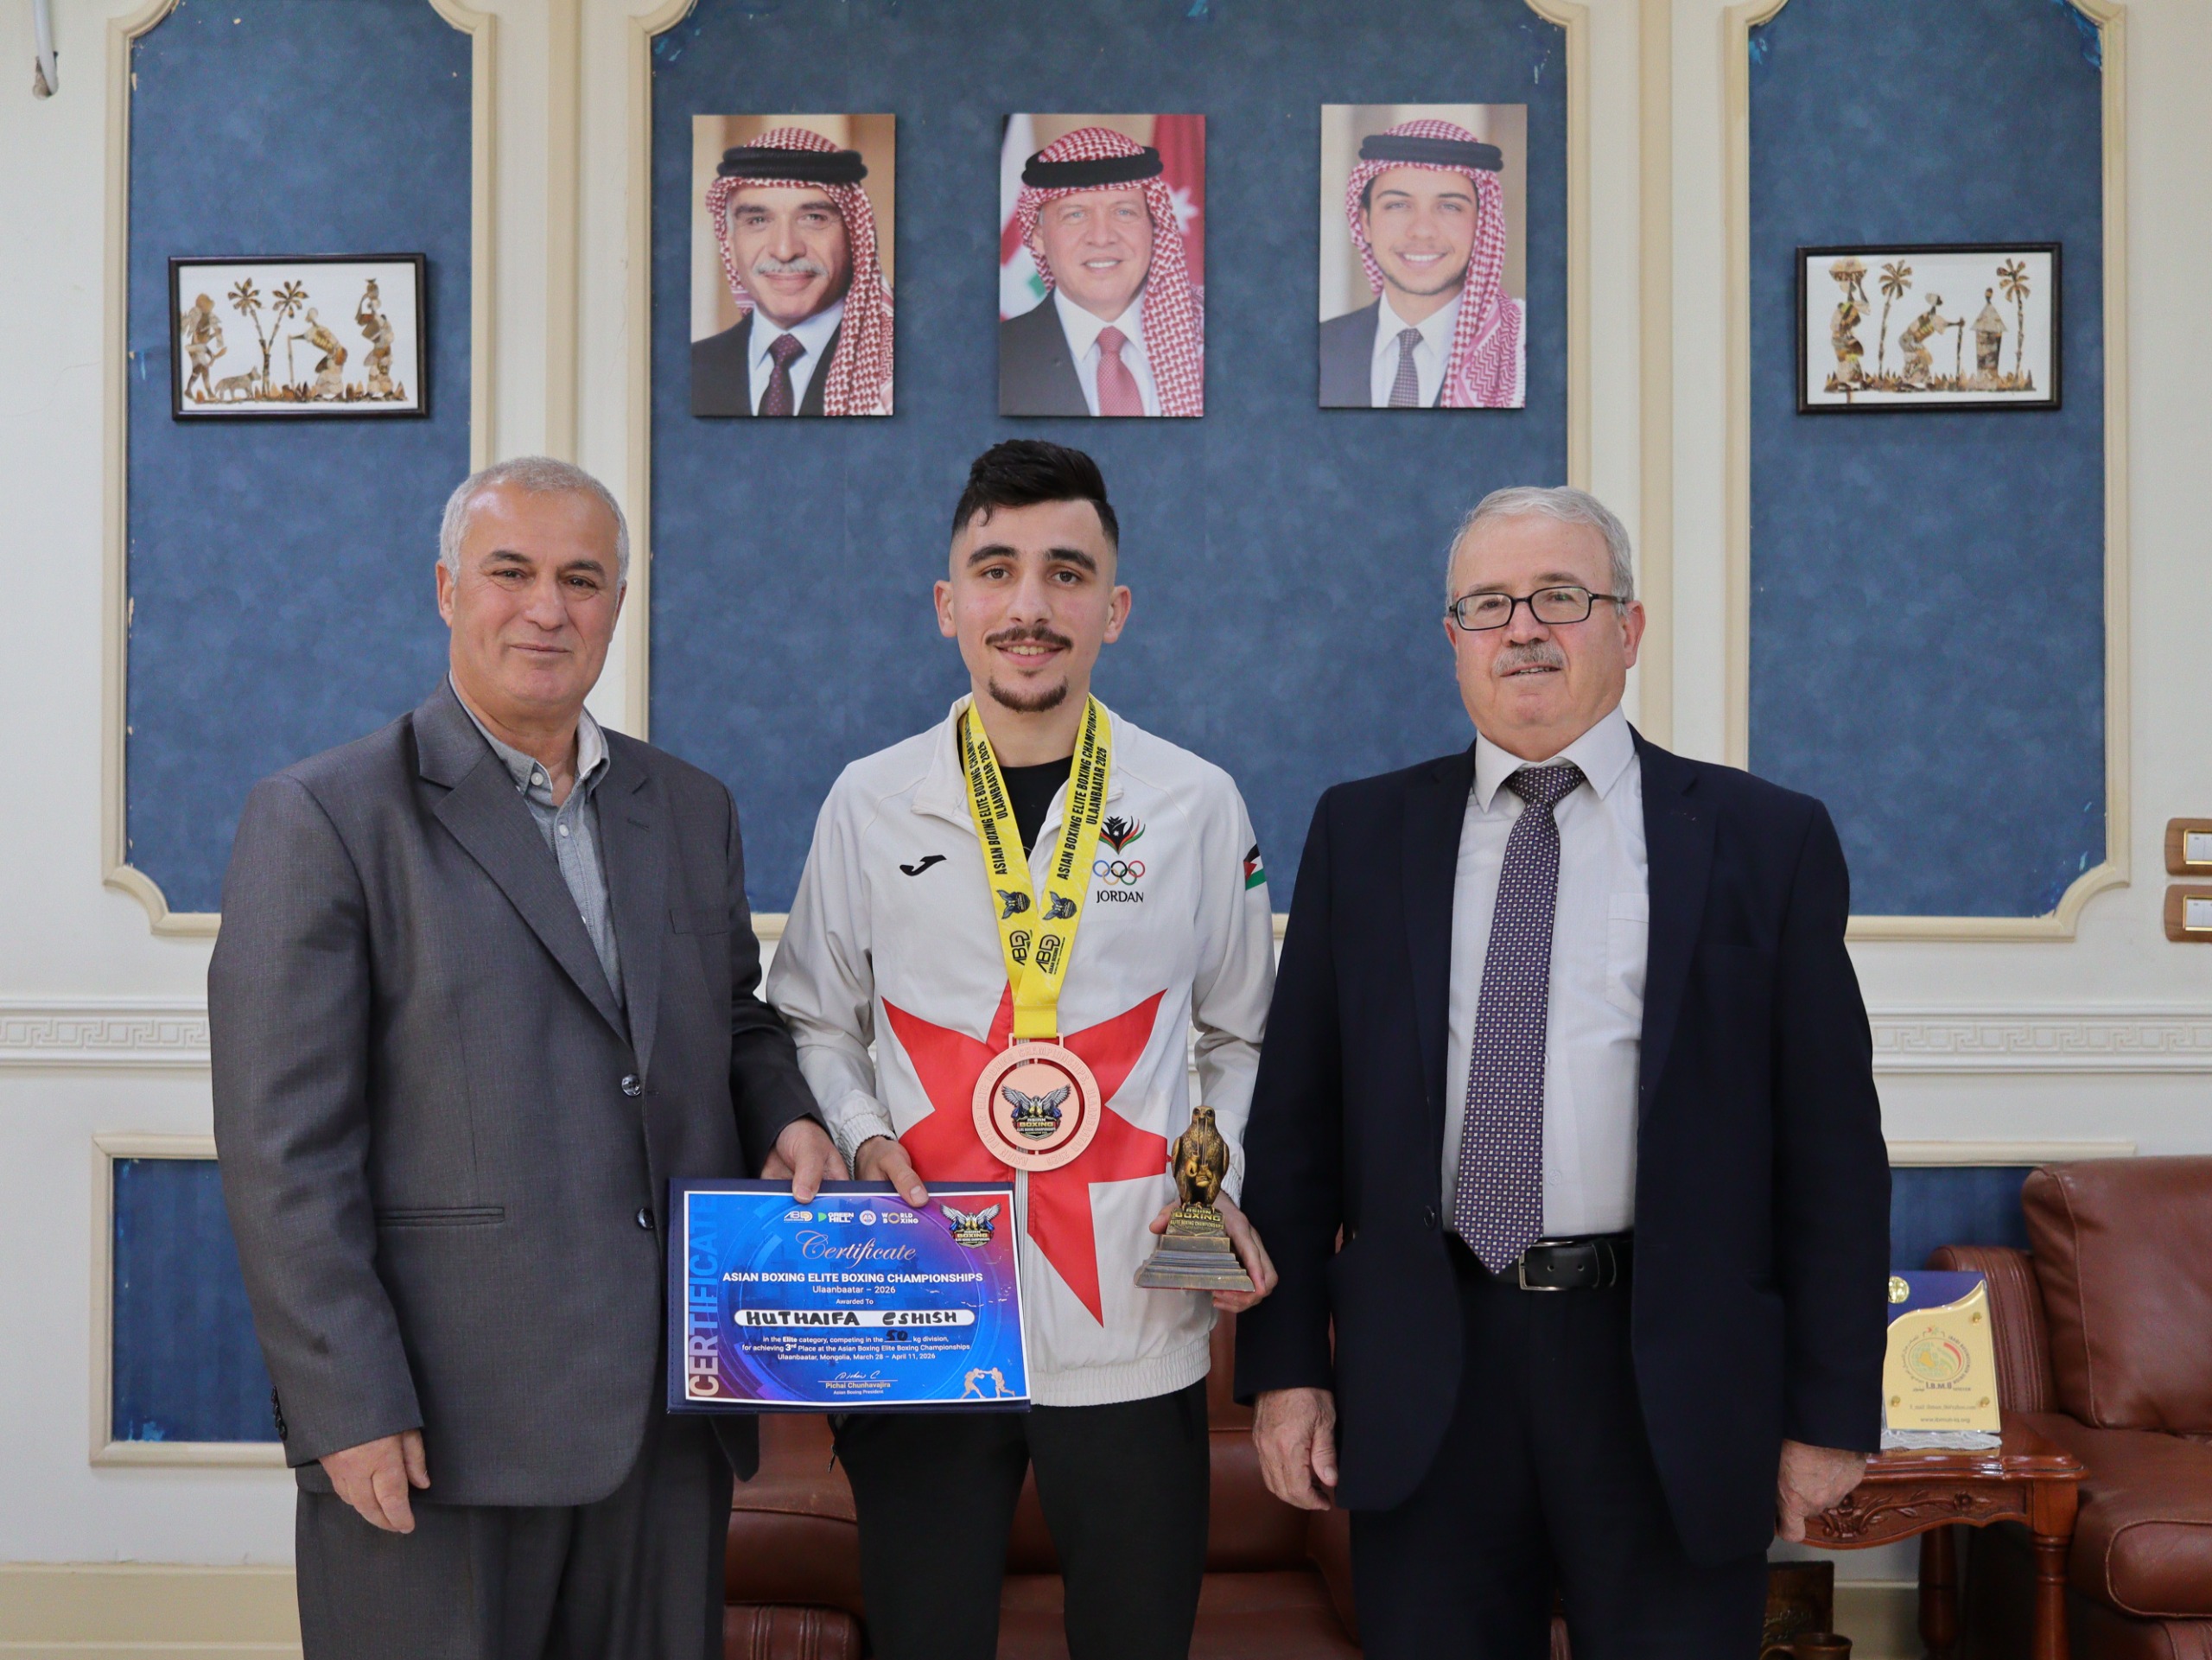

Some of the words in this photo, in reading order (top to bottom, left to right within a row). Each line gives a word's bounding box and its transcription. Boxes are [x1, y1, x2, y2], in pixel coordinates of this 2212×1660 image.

[977, 741, 990, 763] 2026
[970, 770, 985, 797] BOXING
[1077, 759, 1091, 791] BOXING
[1085, 766, 1105, 825] ULAANBAATAR
[1095, 747, 1107, 766] 2026
[983, 760, 1008, 820] ULAANBAATAR
[1071, 791, 1086, 816] ELITE
[976, 796, 991, 818] ELITE
[982, 818, 1001, 846] BOXING
[1065, 816, 1081, 850] BOXING
[991, 847, 1007, 875] ASIAN
[1057, 851, 1074, 880] ASIAN
[1096, 890, 1144, 903] JORDAN
[796, 1230, 916, 1269] Certificate
[722, 1272, 759, 1282] ASIAN
[761, 1272, 805, 1282] BOXING
[808, 1273, 839, 1282] ELITE
[842, 1273, 885, 1282] BOXING
[887, 1273, 983, 1283] CHAMPIONSHIPS
[746, 1311, 861, 1326] HUTHAIFA
[886, 1329, 908, 1341] 50
